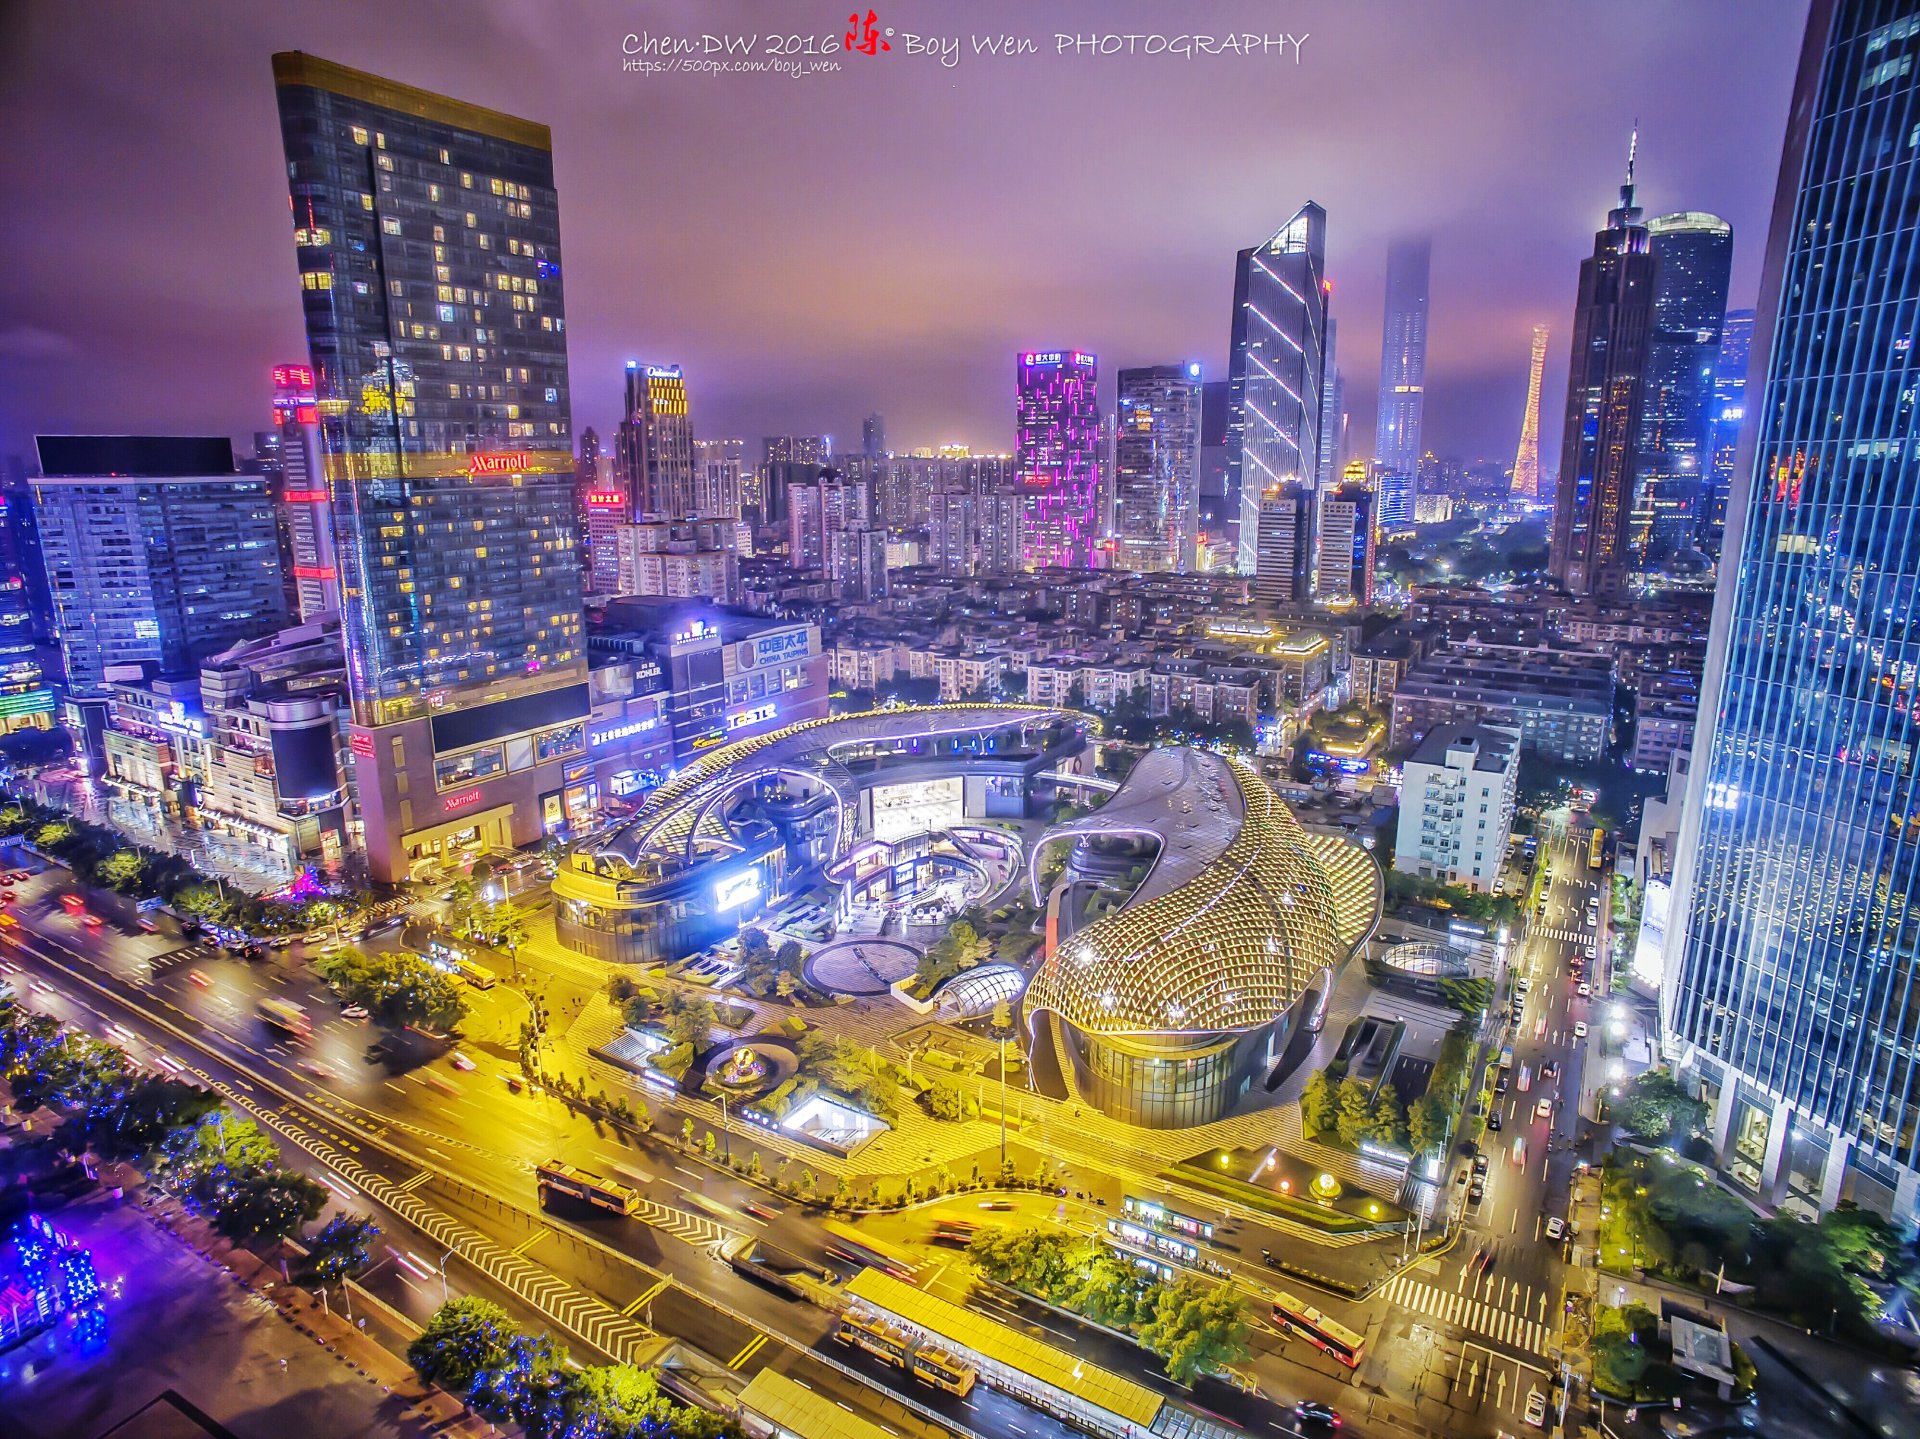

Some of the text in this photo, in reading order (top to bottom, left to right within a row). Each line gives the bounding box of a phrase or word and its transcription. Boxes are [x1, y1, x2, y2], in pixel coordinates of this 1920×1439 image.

[470, 454, 527, 473] Marriott
[759, 630, 808, 654] 中国太平
[759, 647, 808, 665] CHINA TAIPING
[636, 667, 662, 680] KOHLER
[445, 791, 480, 811] Marriott
